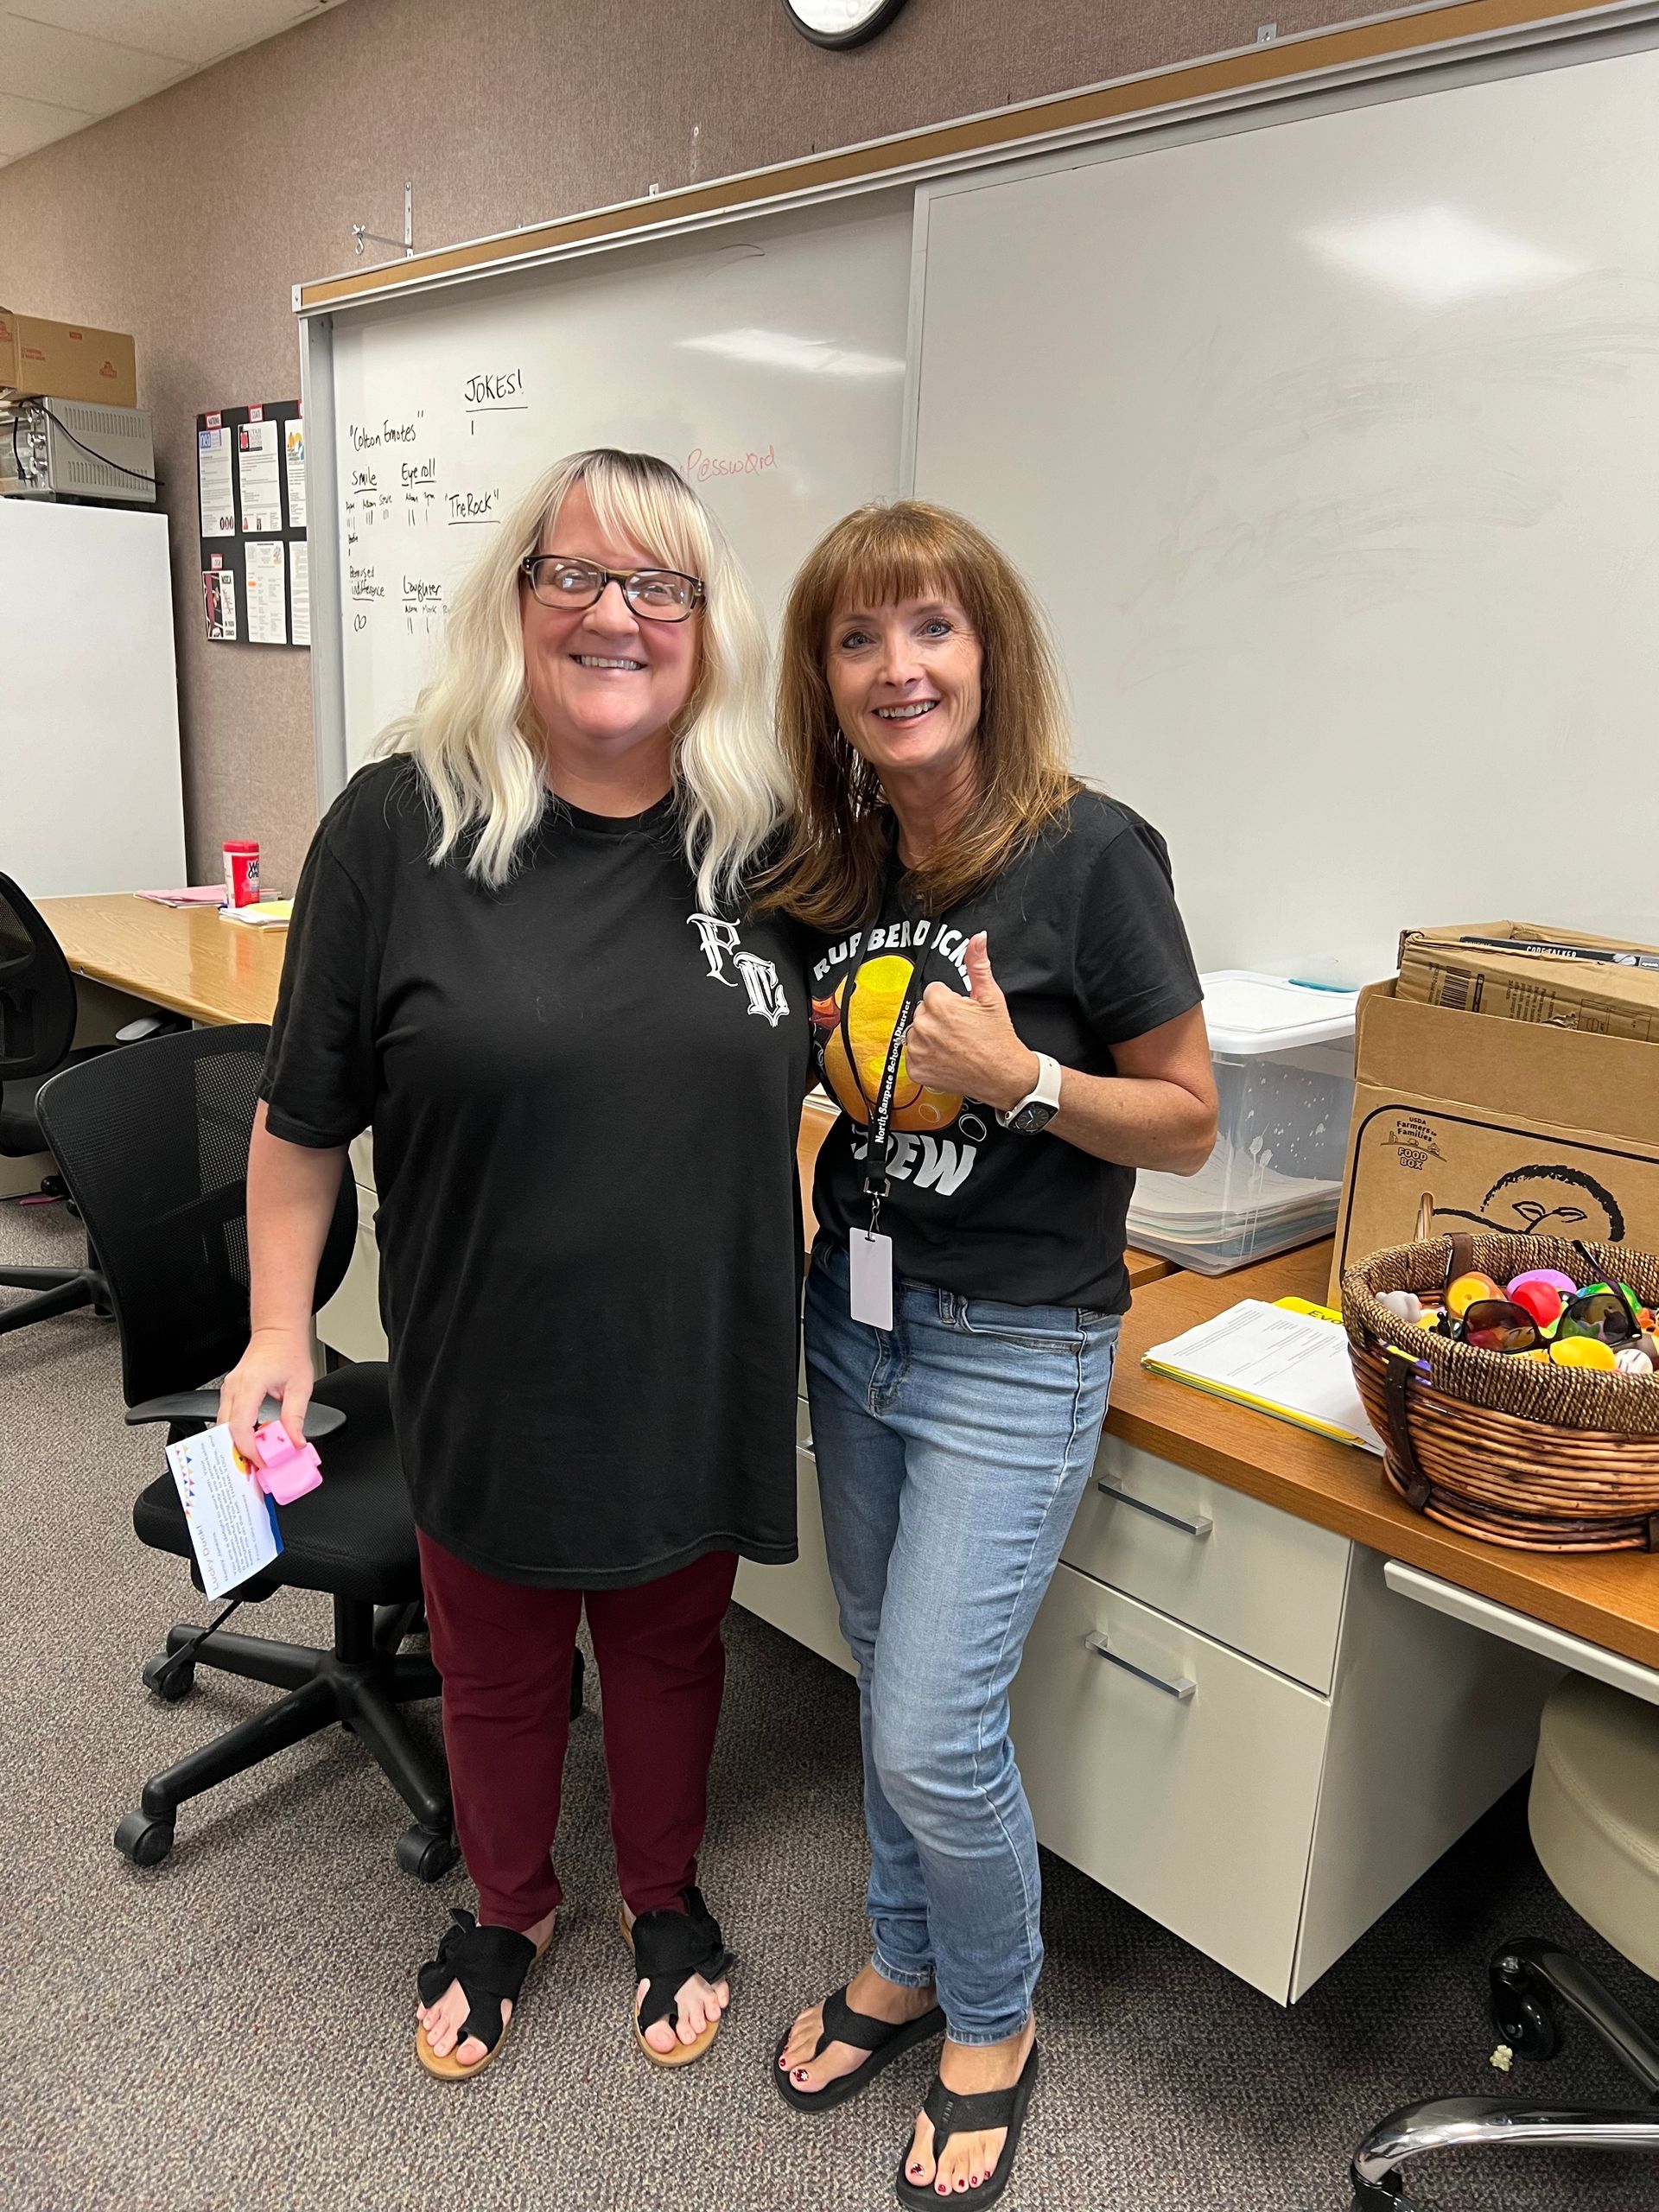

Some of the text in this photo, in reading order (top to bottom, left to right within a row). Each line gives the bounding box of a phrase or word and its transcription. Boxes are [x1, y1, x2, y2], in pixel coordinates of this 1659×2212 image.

[465, 368, 524, 403] JOKES!
[874, 1000, 911, 1144] North Sanpete School District
[1409, 1116, 1426, 1125] USDA
[1396, 1121, 1431, 1134] Farmers
[1397, 1128, 1433, 1141] Families
[1398, 1147, 1427, 1161] FOOD
[1400, 1157, 1424, 1170] BOX
[206, 1557, 220, 1591] Lucky
